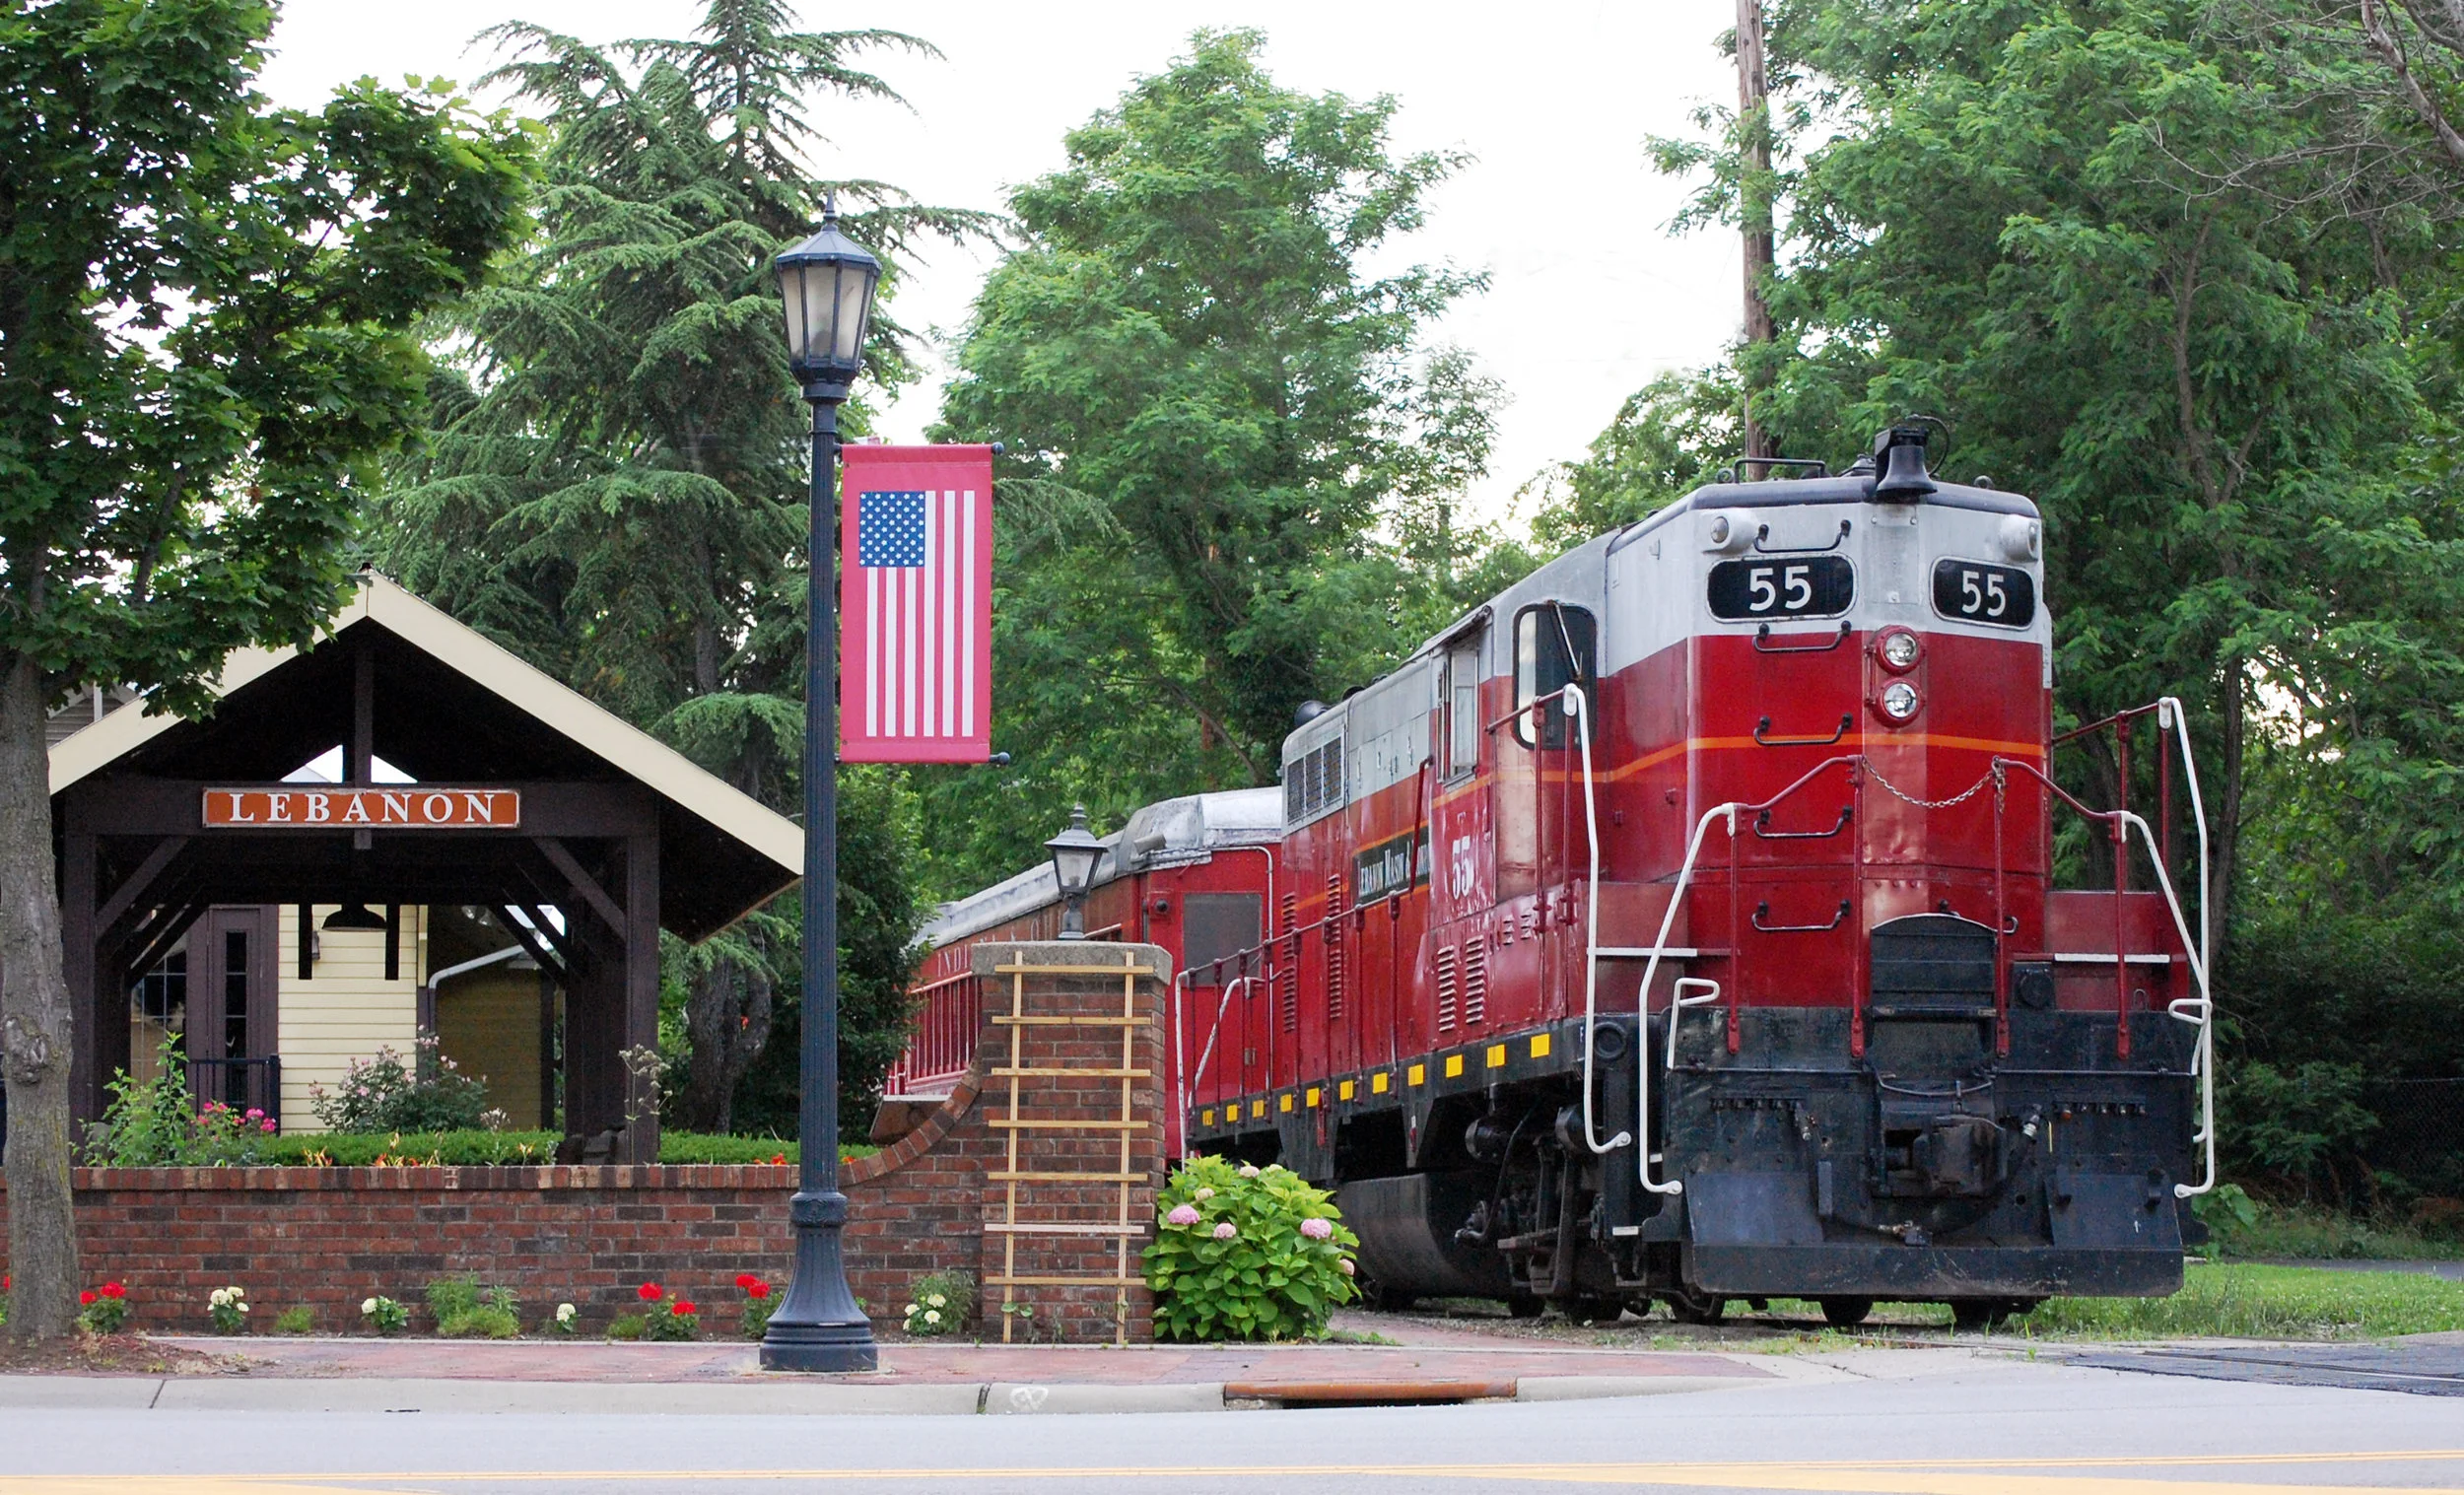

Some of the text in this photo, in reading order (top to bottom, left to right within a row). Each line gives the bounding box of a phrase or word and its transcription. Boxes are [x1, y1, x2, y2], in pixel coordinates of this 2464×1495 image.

[1748, 565, 1813, 612] 55
[1960, 570, 2007, 617] 55
[229, 792, 495, 823] LEBANON
[1452, 835, 1474, 901] 55
